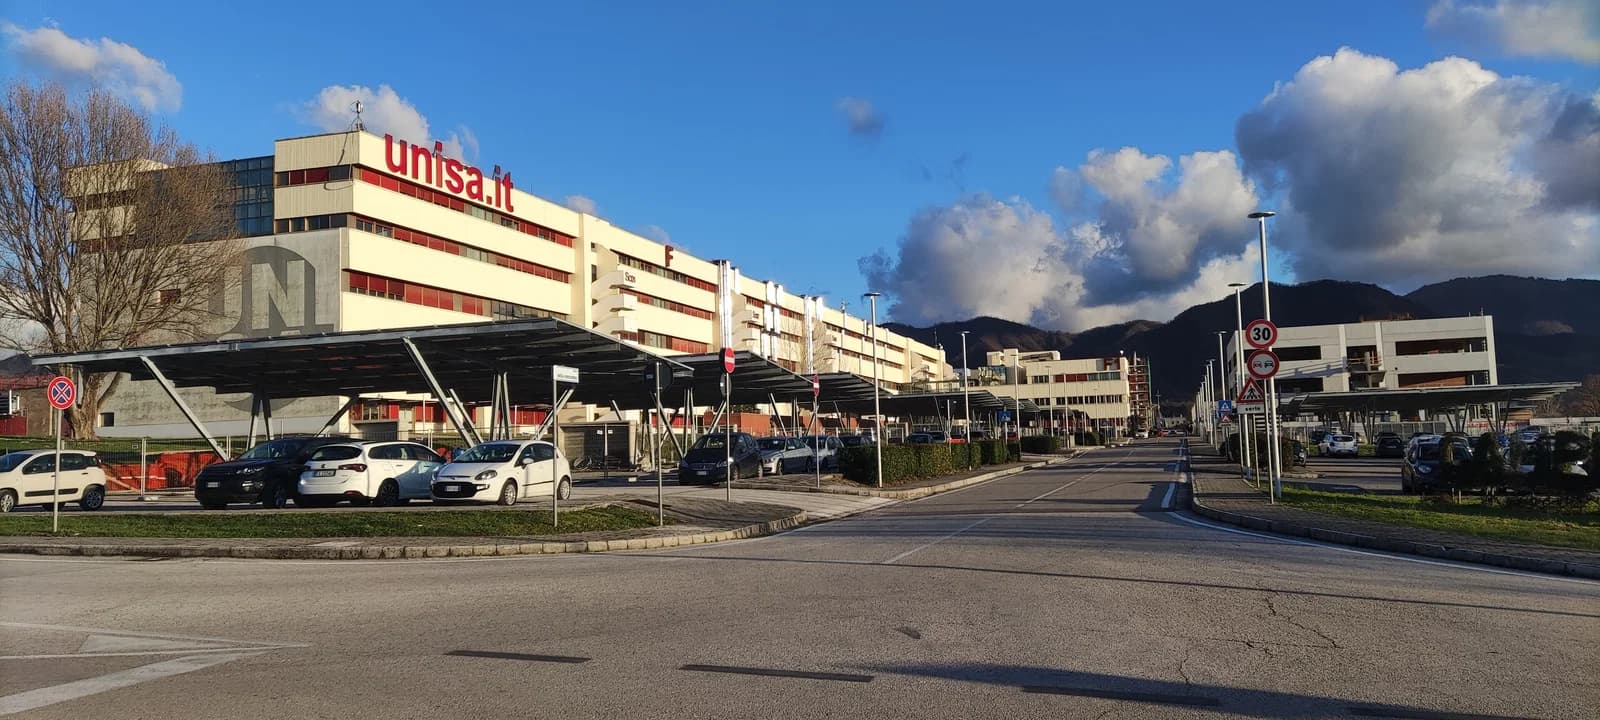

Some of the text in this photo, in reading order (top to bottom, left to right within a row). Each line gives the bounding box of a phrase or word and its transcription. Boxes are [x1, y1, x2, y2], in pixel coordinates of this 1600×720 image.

[384, 133, 514, 213] unisa.it
[664, 244, 674, 267] F
[1253, 327, 1271, 341] 30
